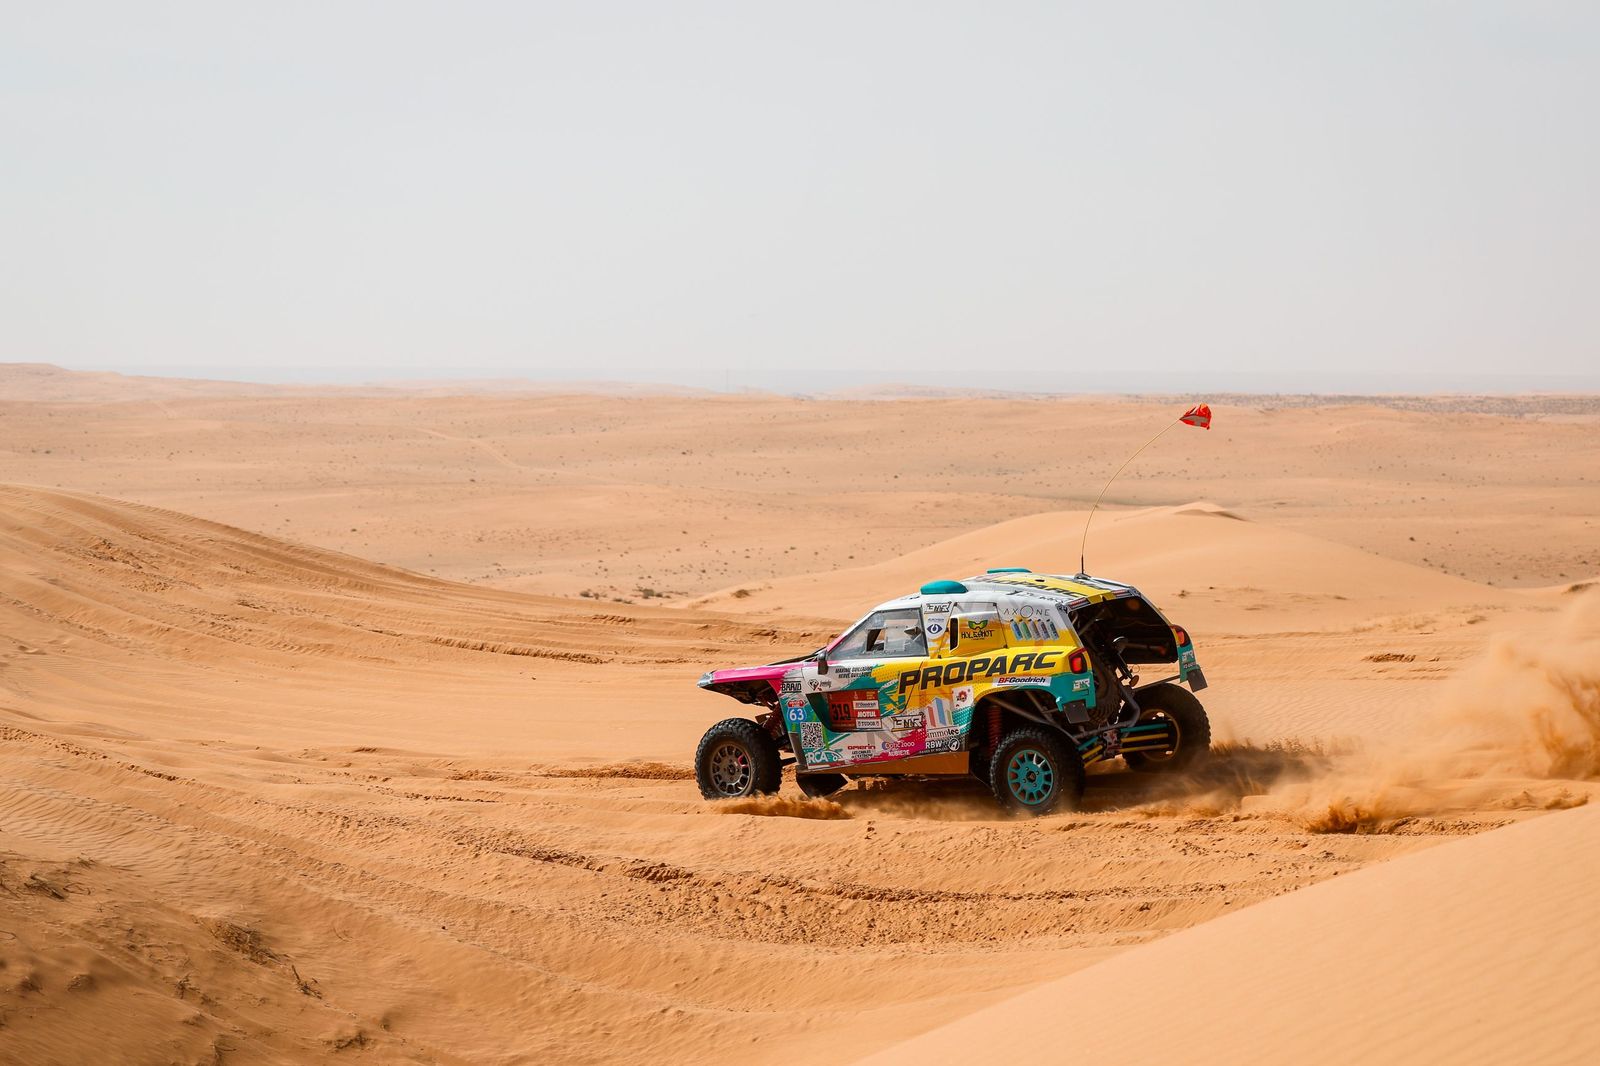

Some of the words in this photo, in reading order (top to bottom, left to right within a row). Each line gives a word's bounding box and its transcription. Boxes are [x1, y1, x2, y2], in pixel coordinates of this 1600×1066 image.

[1003, 605, 1050, 618] AXONE
[898, 651, 1063, 694] PROPARC
[789, 709, 804, 721] 63
[831, 703, 851, 721] 319
[926, 740, 943, 750] RBW
